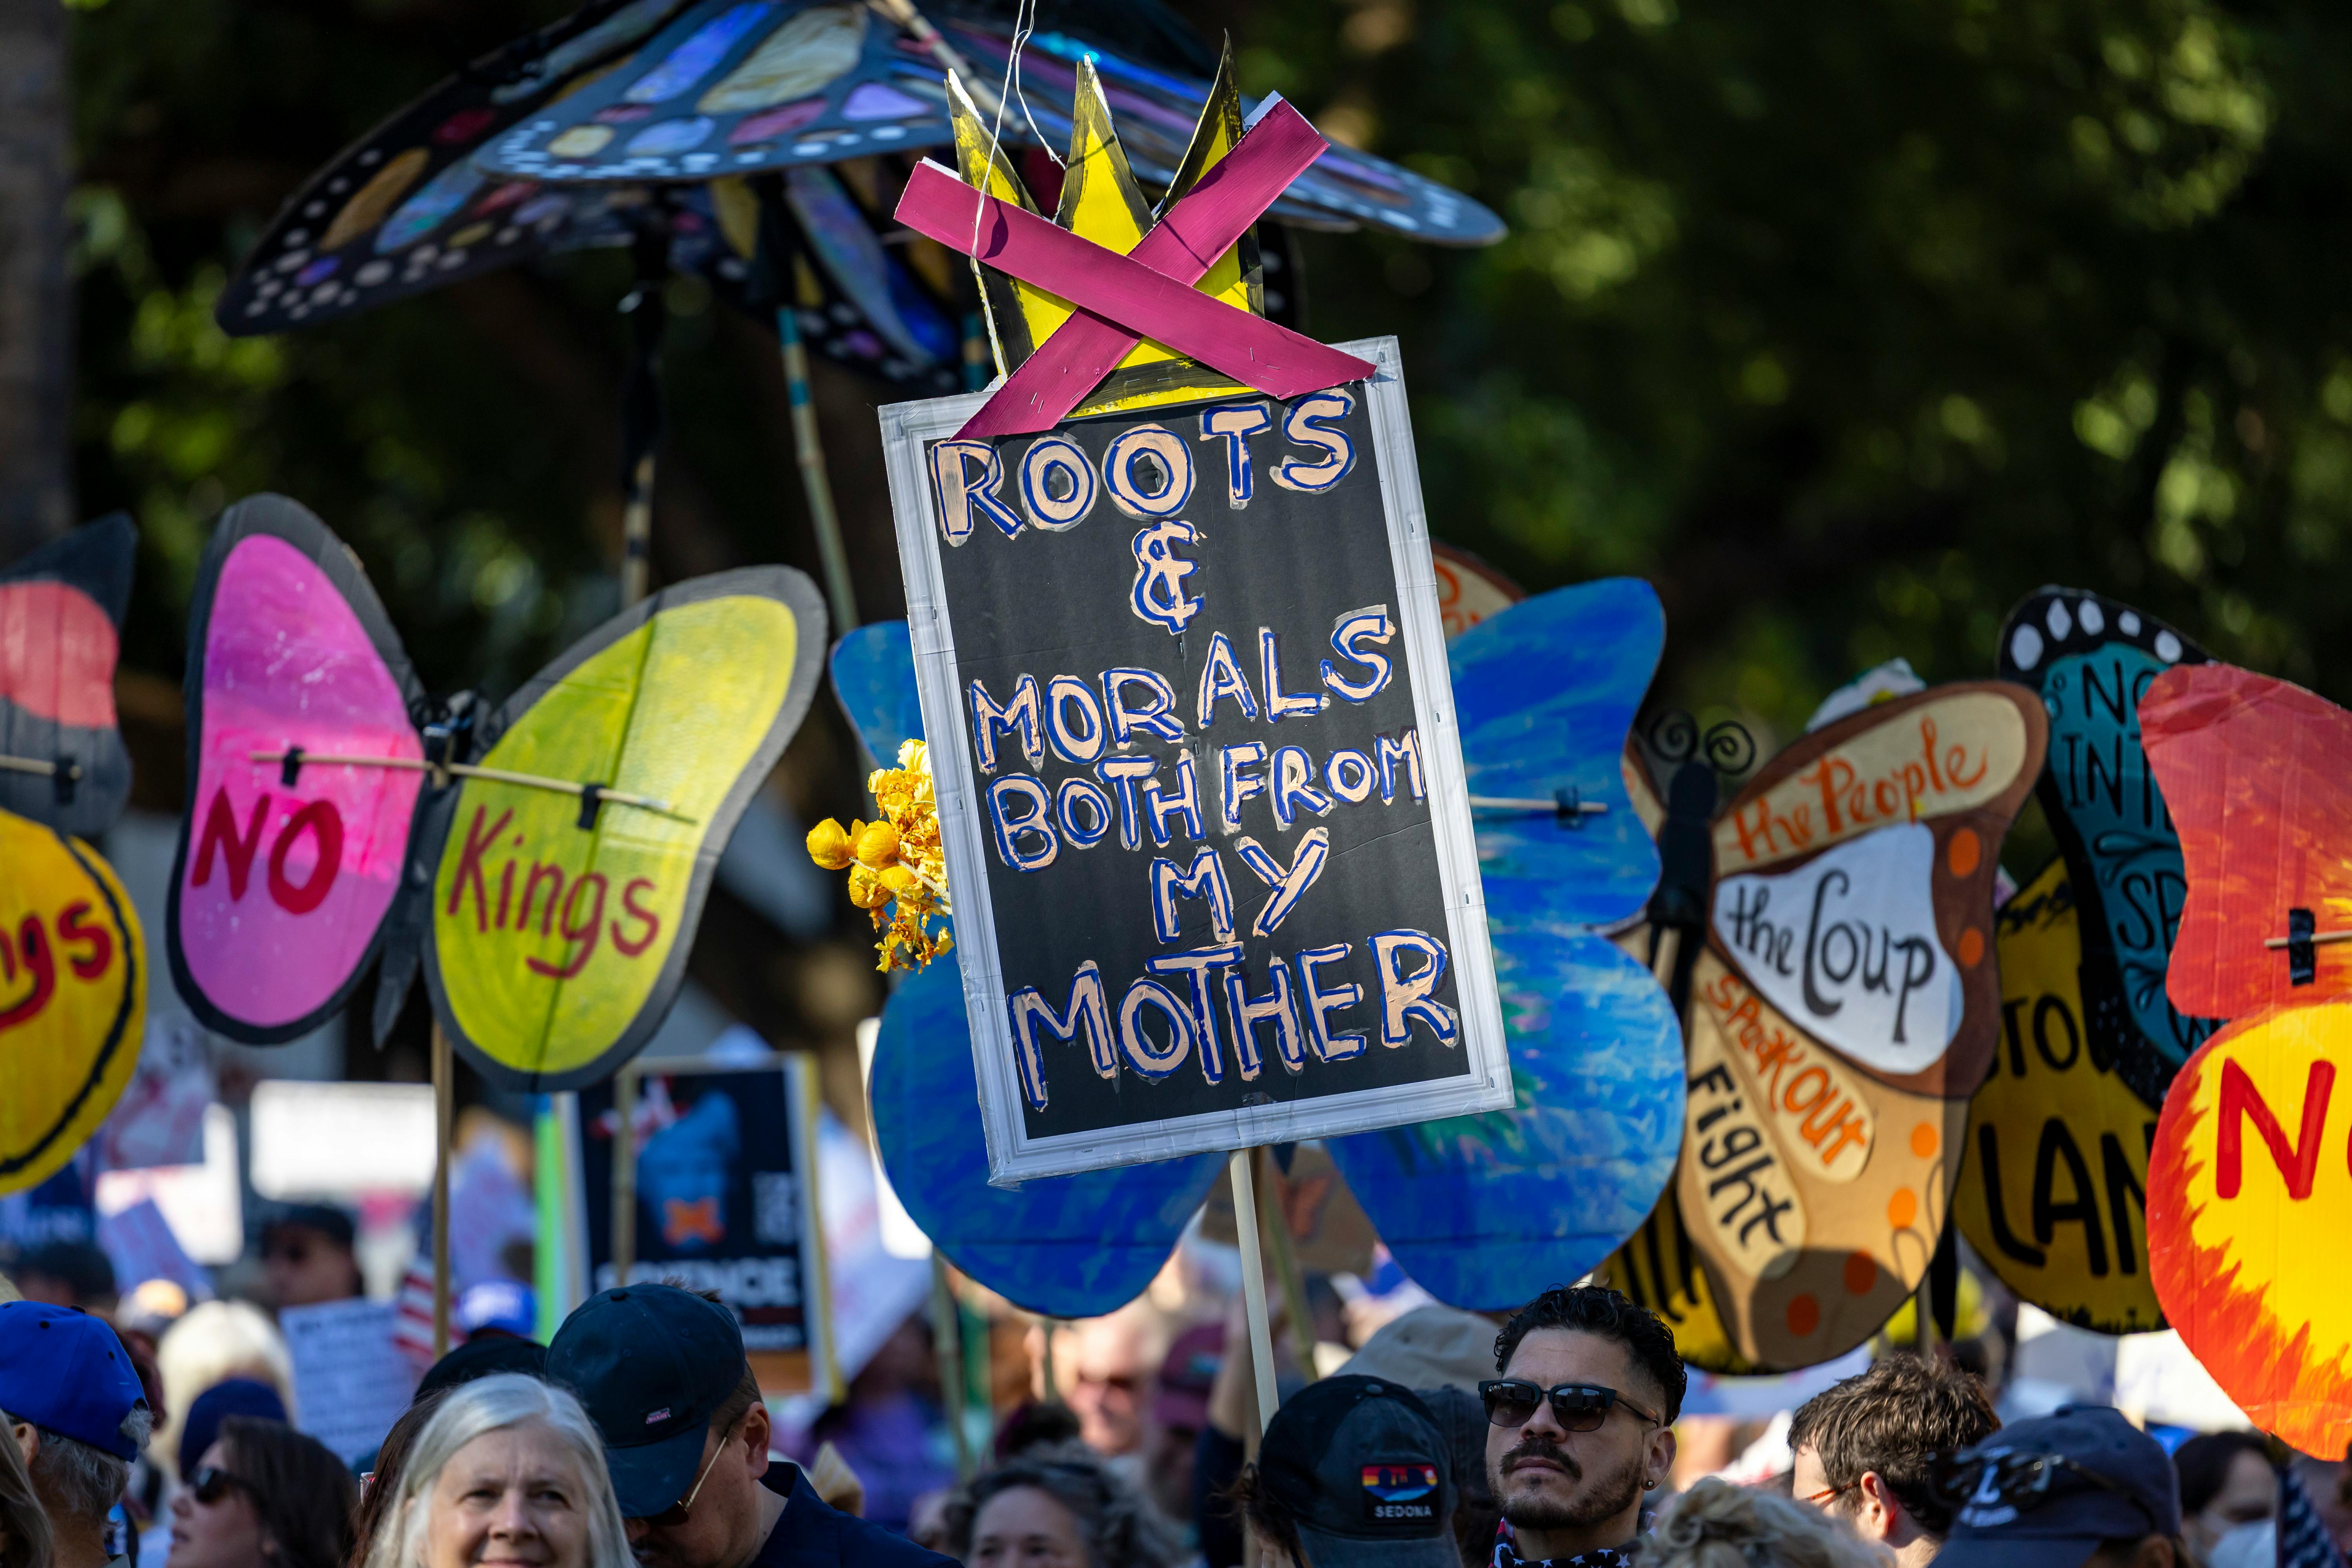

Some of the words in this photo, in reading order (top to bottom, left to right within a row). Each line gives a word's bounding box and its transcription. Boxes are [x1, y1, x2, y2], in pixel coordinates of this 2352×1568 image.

[932, 392, 1356, 546] ROOTS
[1131, 520, 1207, 634] &
[970, 606, 1396, 774] MORALS
[986, 747, 1207, 873] BOTH
[1218, 725, 1425, 835] FROM
[1798, 715, 1989, 826] People
[191, 787, 345, 915] NO
[448, 804, 660, 979] Kings
[1150, 826, 1328, 944] MY
[1726, 884, 1795, 977] the
[1803, 868, 1936, 1044] Coup
[1007, 929, 1459, 1112] MOTHER
[1688, 1063, 1793, 1246] Fight
[2216, 1056, 2352, 1202] N
[1374, 1505, 1432, 1518] SEDONA
